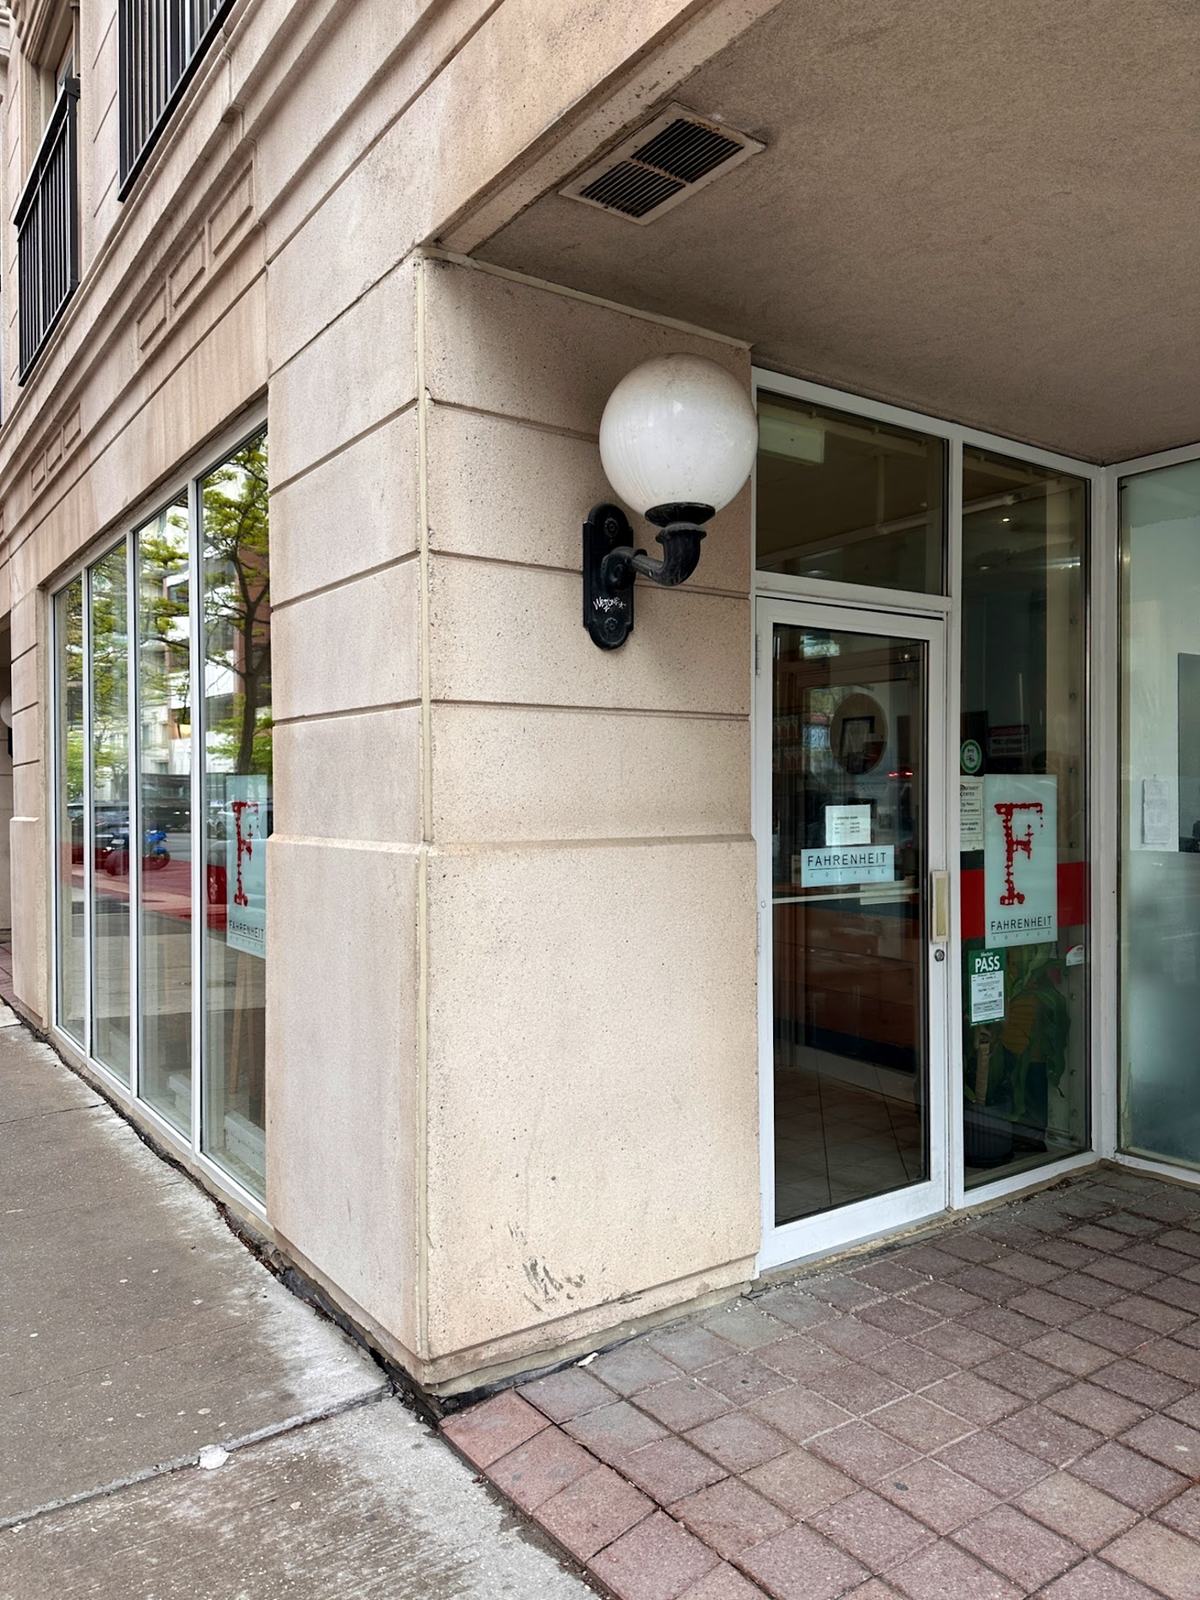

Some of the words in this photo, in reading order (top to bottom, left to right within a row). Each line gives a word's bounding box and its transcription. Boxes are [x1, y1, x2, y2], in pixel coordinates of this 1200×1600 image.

[807, 852, 886, 867] FAHRENHEIT
[229, 919, 264, 940] FAHRENHEIT
[990, 915, 1052, 931] FAHRENHEIT
[975, 955, 1001, 973] PASS
